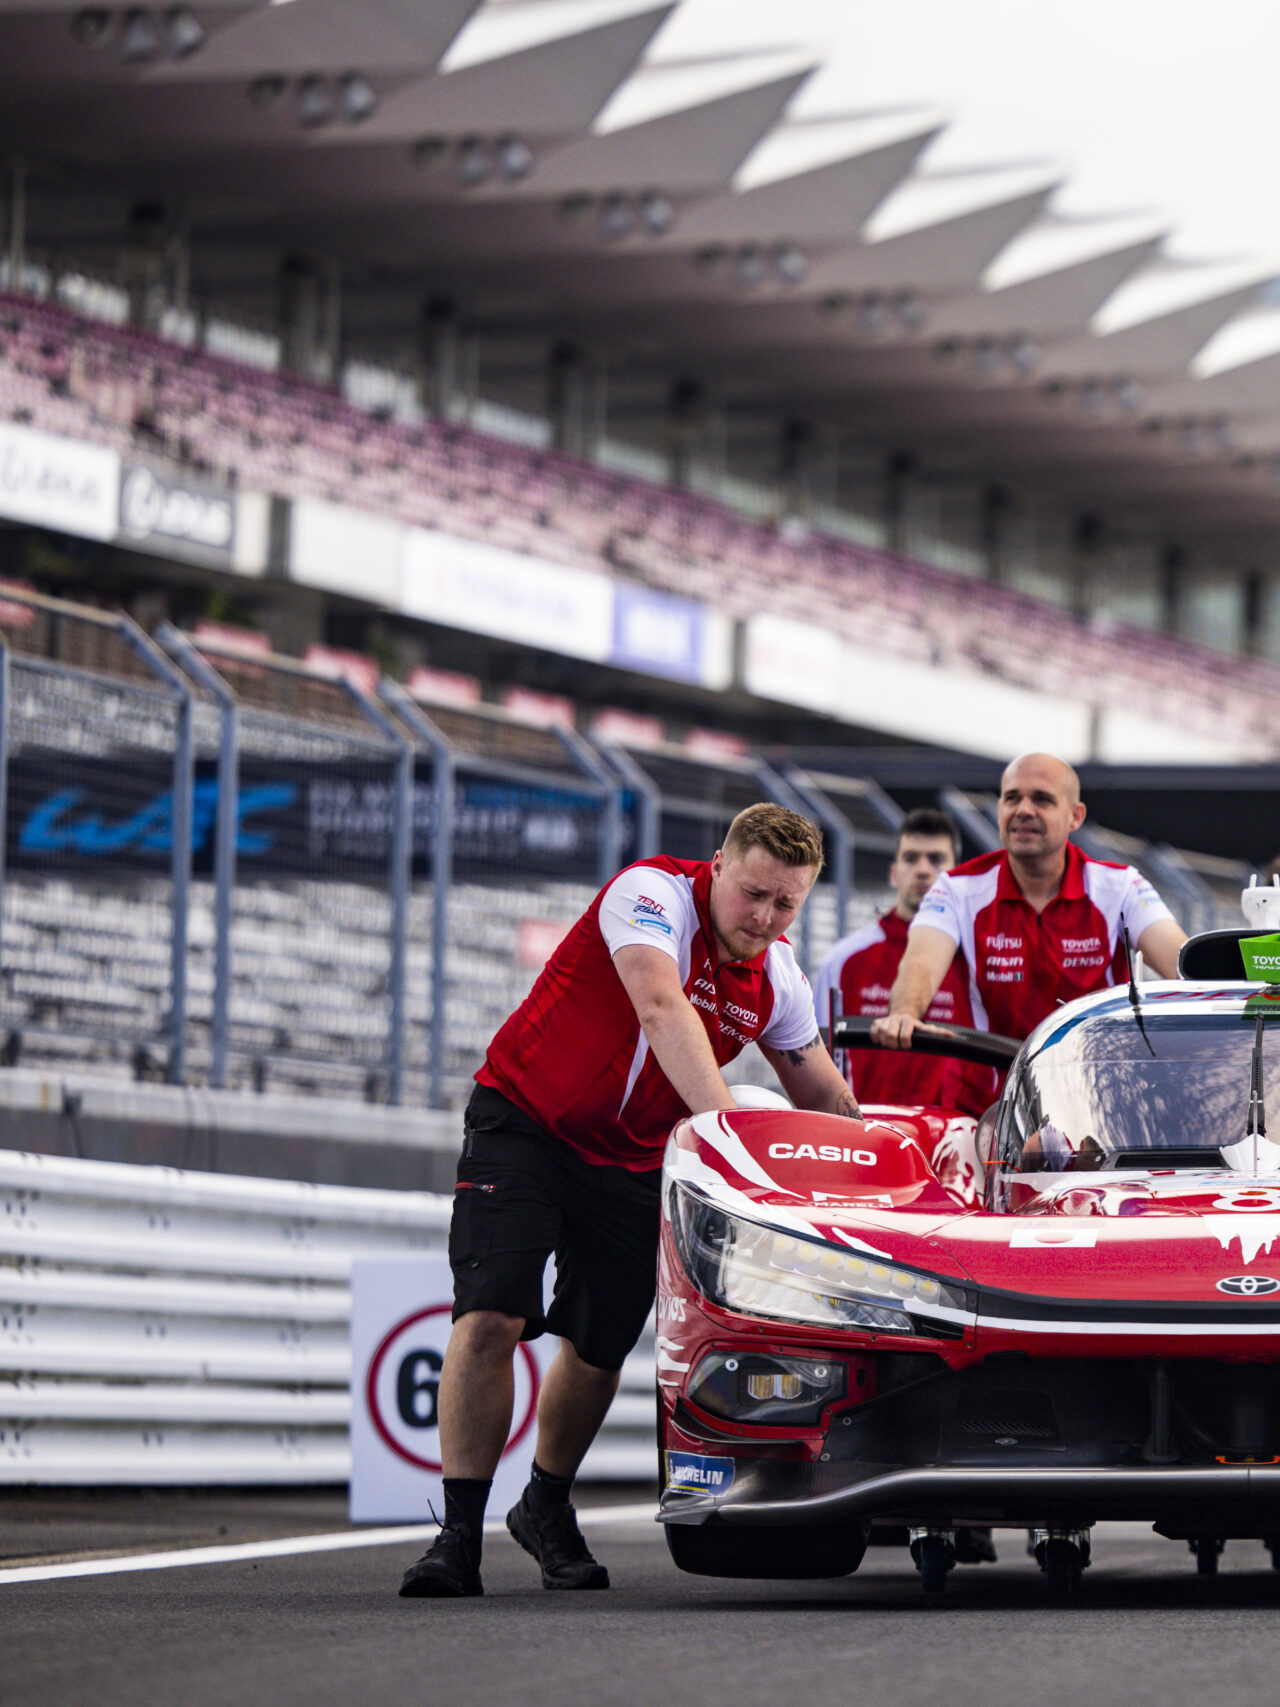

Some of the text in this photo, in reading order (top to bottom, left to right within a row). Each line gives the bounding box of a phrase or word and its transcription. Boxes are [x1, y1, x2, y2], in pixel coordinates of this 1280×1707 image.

[986, 932, 1022, 951] FUJITSU
[1062, 938, 1100, 949] TOYOTA
[1062, 955, 1104, 968] DENSO
[694, 978, 716, 995] AIS
[690, 993, 717, 1013] Mobil
[725, 1001, 759, 1024] TOYOTA
[768, 1143, 878, 1166] CASIO
[657, 1295, 687, 1322] DVICS
[396, 1349, 444, 1430] 6
